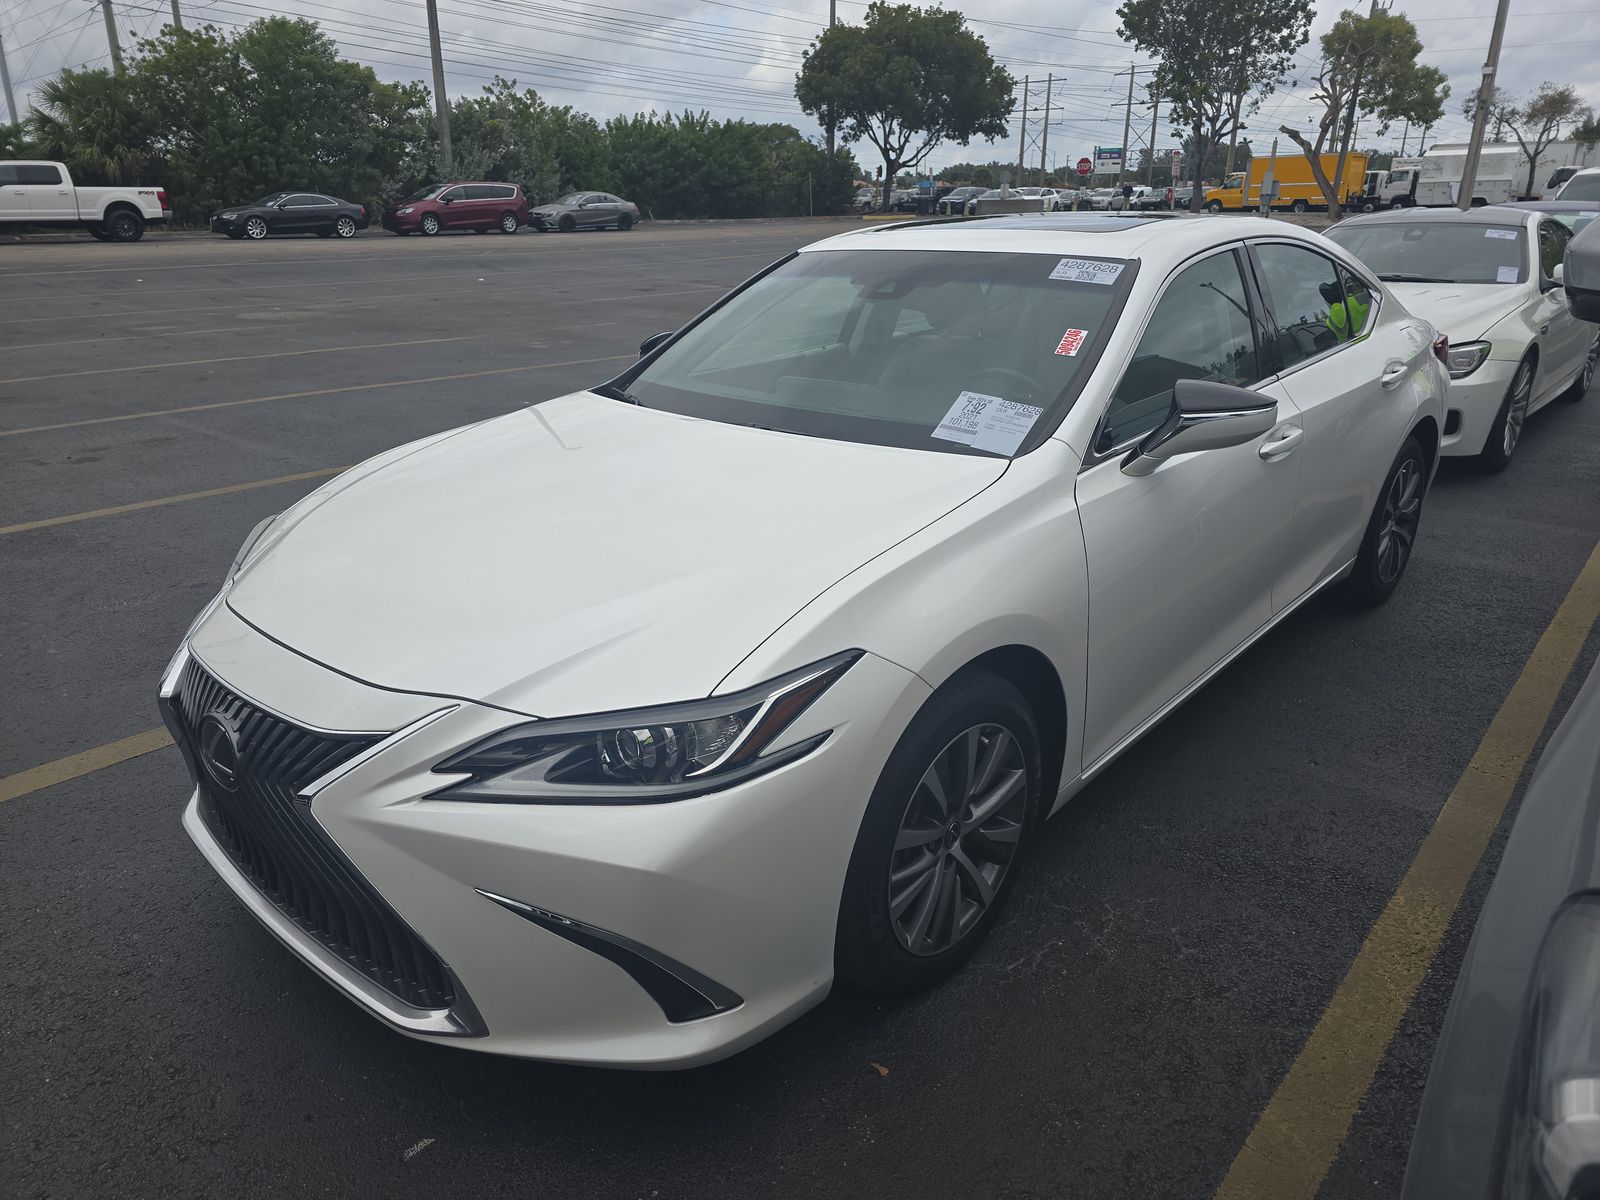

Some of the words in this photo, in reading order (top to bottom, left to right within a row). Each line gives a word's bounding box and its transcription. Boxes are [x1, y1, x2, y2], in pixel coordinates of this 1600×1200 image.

[1077, 162, 1091, 170] STOP
[1061, 260, 1118, 273] 4287628
[961, 400, 987, 415] 7:92
[998, 401, 1043, 416] 4287628
[958, 411, 978, 421] 2021
